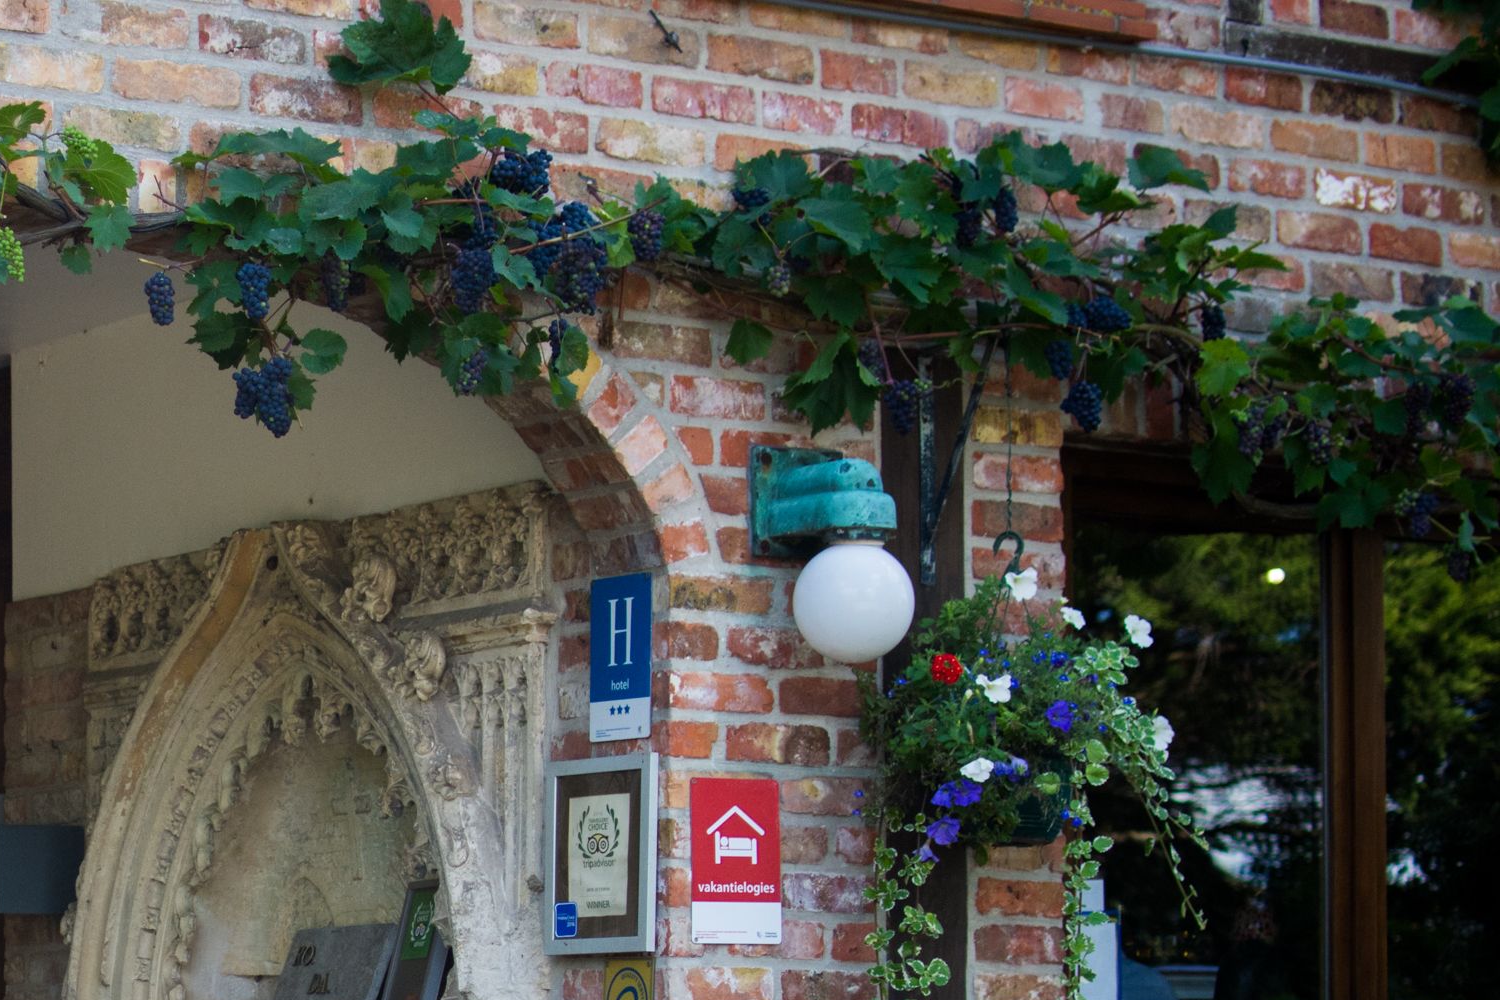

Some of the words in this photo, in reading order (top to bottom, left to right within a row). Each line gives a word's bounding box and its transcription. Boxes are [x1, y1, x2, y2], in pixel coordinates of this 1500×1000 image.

[608, 597, 635, 666] H
[610, 678, 630, 691] hotel
[587, 823, 609, 831] CHOICE
[583, 858, 614, 870] tripadvisor
[698, 880, 775, 897] vakantielogies
[586, 900, 610, 909] WINNER
